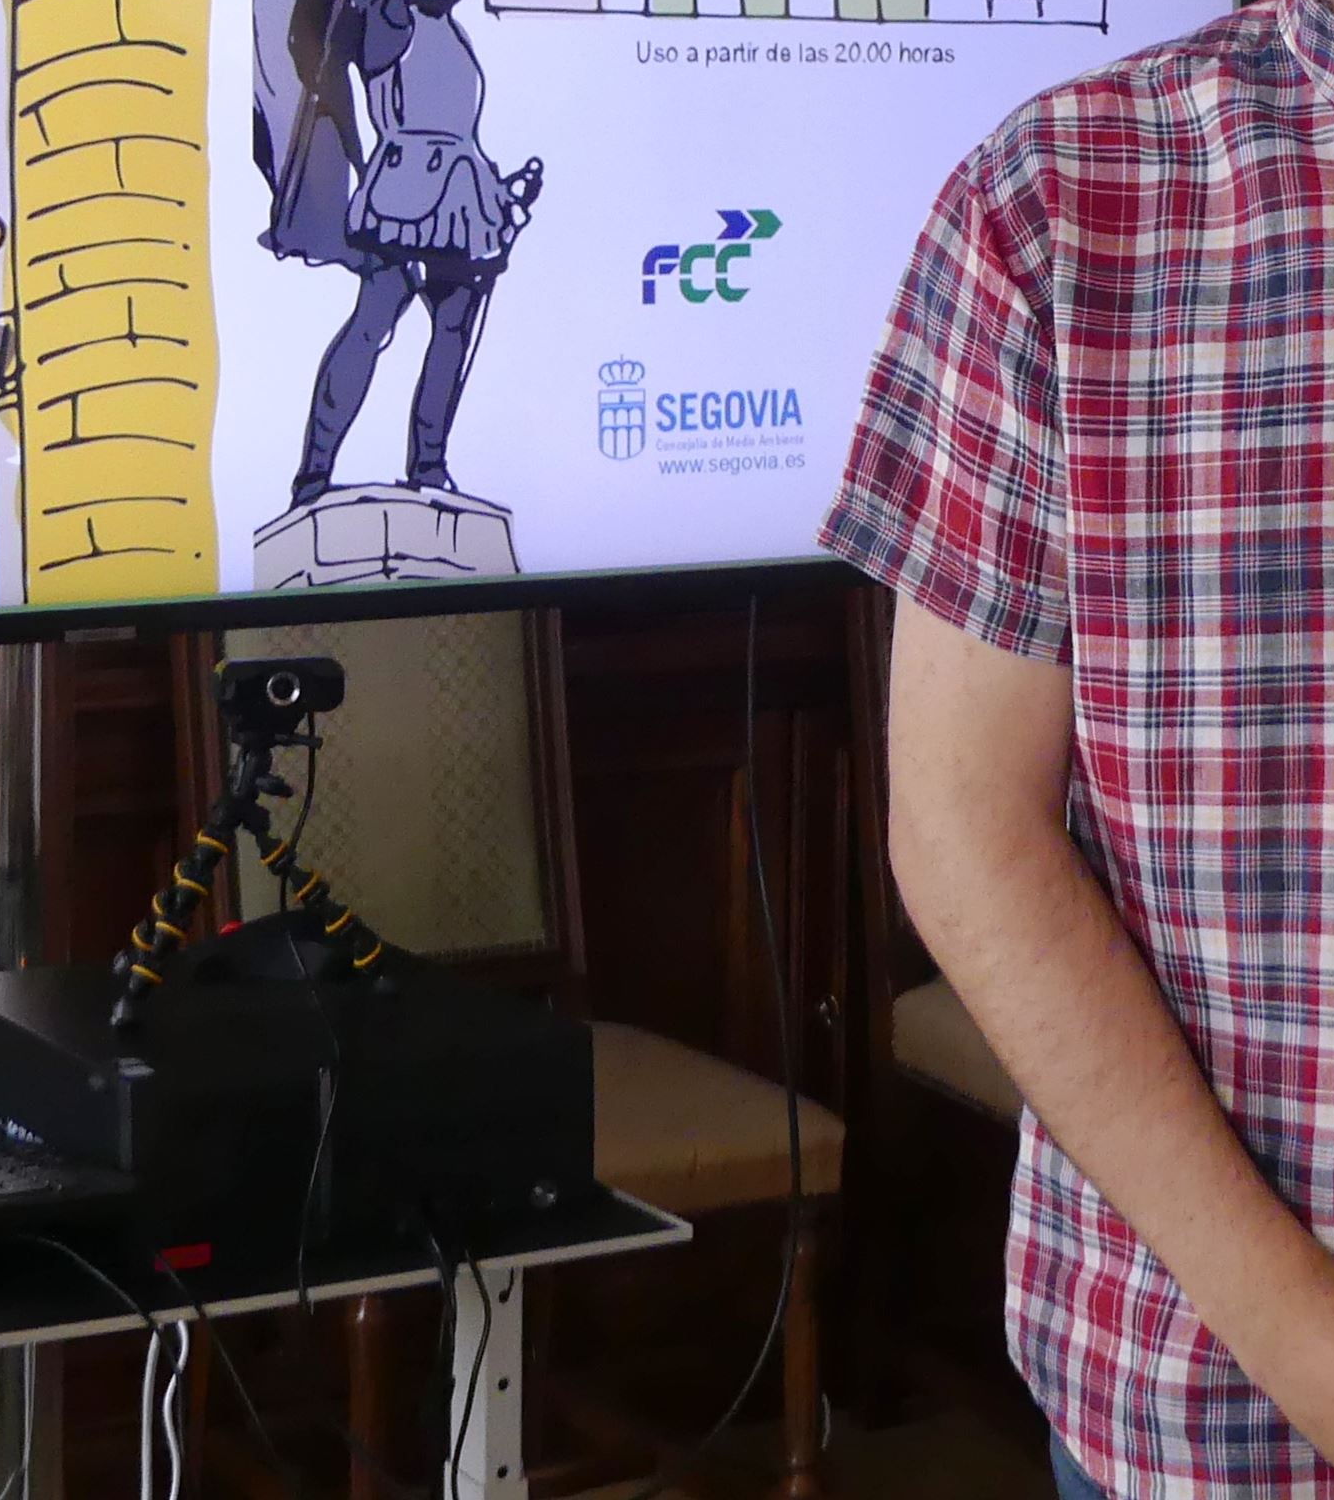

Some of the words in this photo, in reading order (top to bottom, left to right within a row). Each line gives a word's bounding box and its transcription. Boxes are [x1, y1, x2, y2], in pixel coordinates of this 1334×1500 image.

[637, 41, 678, 64] Uso
[687, 47, 698, 62] a
[706, 43, 758, 67] partir
[766, 43, 790, 62] de
[800, 44, 828, 63] las
[900, 42, 955, 63] horas
[642, 244, 751, 304] FCC
[656, 389, 802, 432] SEGOVIA
[658, 452, 805, 475] www.segovia.es
